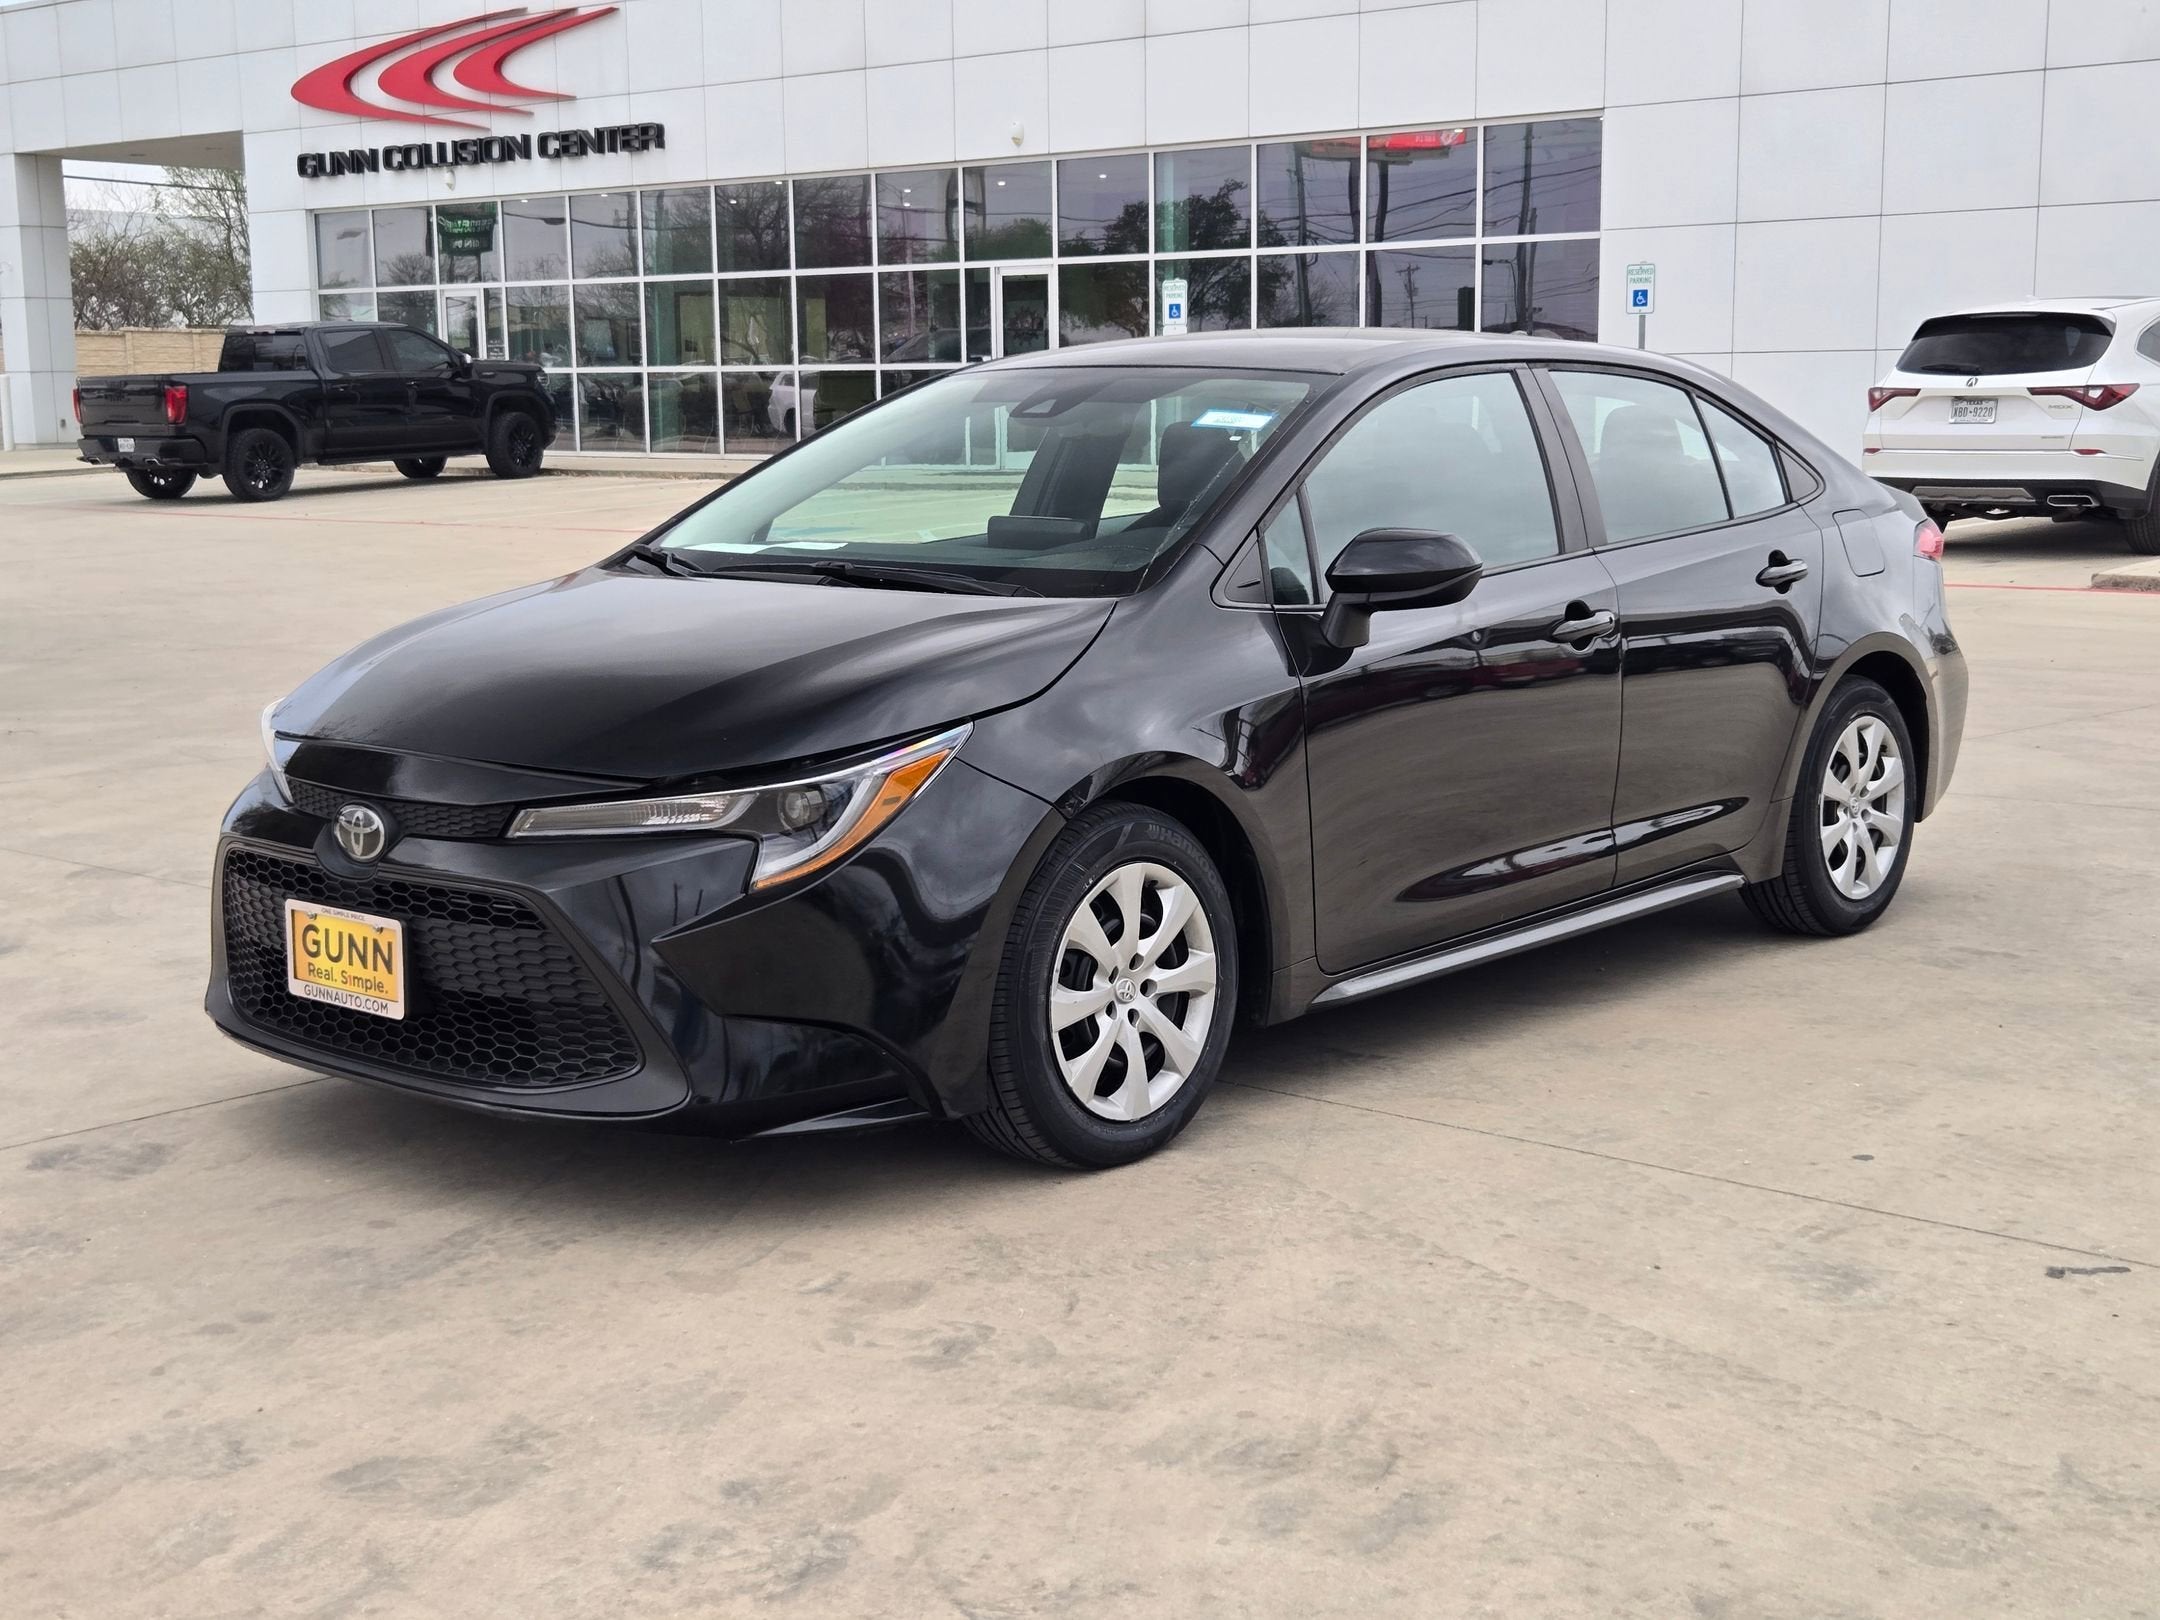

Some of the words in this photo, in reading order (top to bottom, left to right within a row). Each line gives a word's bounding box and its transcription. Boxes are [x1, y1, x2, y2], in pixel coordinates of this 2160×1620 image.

[297, 148, 380, 178] GUNN
[382, 134, 532, 171] COLLISION
[537, 122, 666, 159] CENTER
[1628, 268, 1654, 276] RESERVED
[302, 923, 393, 975] GUNN
[307, 962, 338, 983] Real.
[303, 984, 389, 1015] GUNNAUTO.COM
